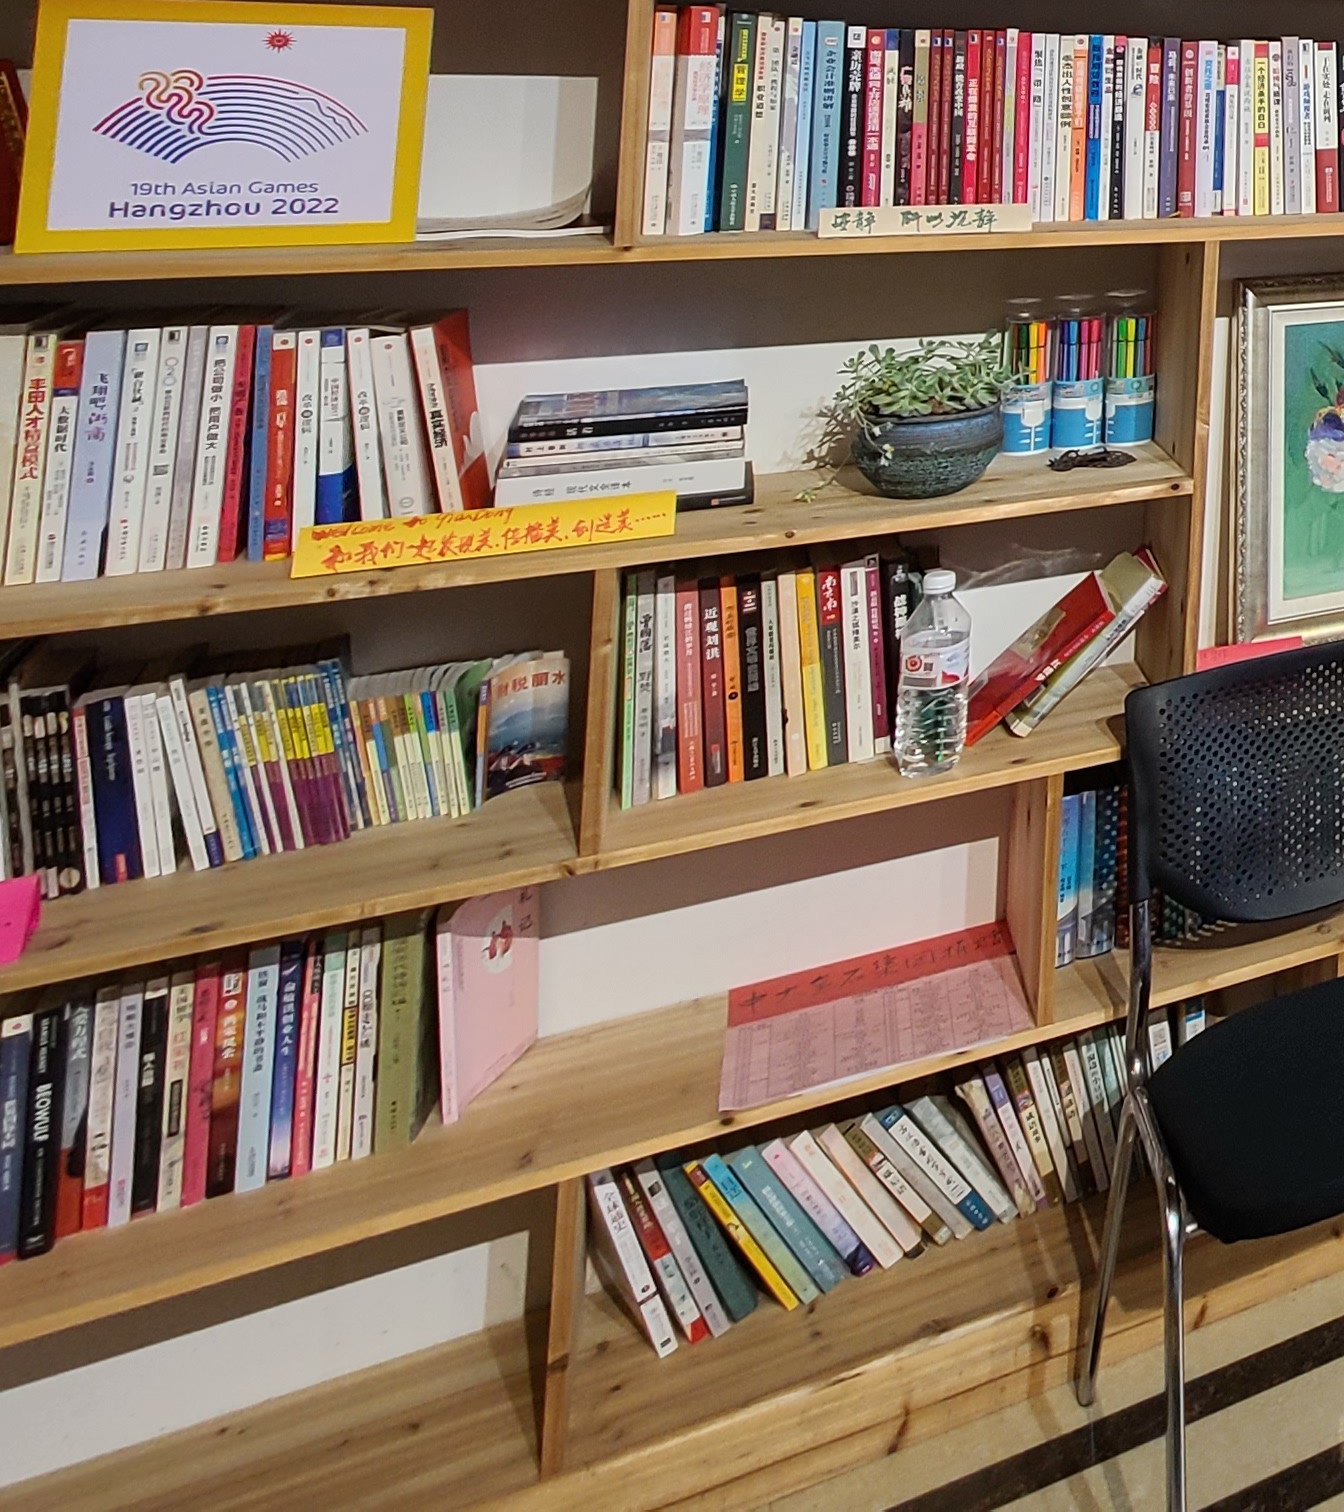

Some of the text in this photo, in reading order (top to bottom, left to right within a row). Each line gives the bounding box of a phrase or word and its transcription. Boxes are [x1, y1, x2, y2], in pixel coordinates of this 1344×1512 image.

[735, 63, 746, 102] 管理学
[130, 180, 320, 197] 19th Asian Games
[108, 197, 340, 221] Hangzhou 2022
[19, 377, 47, 481] 丰田人才精益模式
[53, 405, 72, 453] 大数据时代
